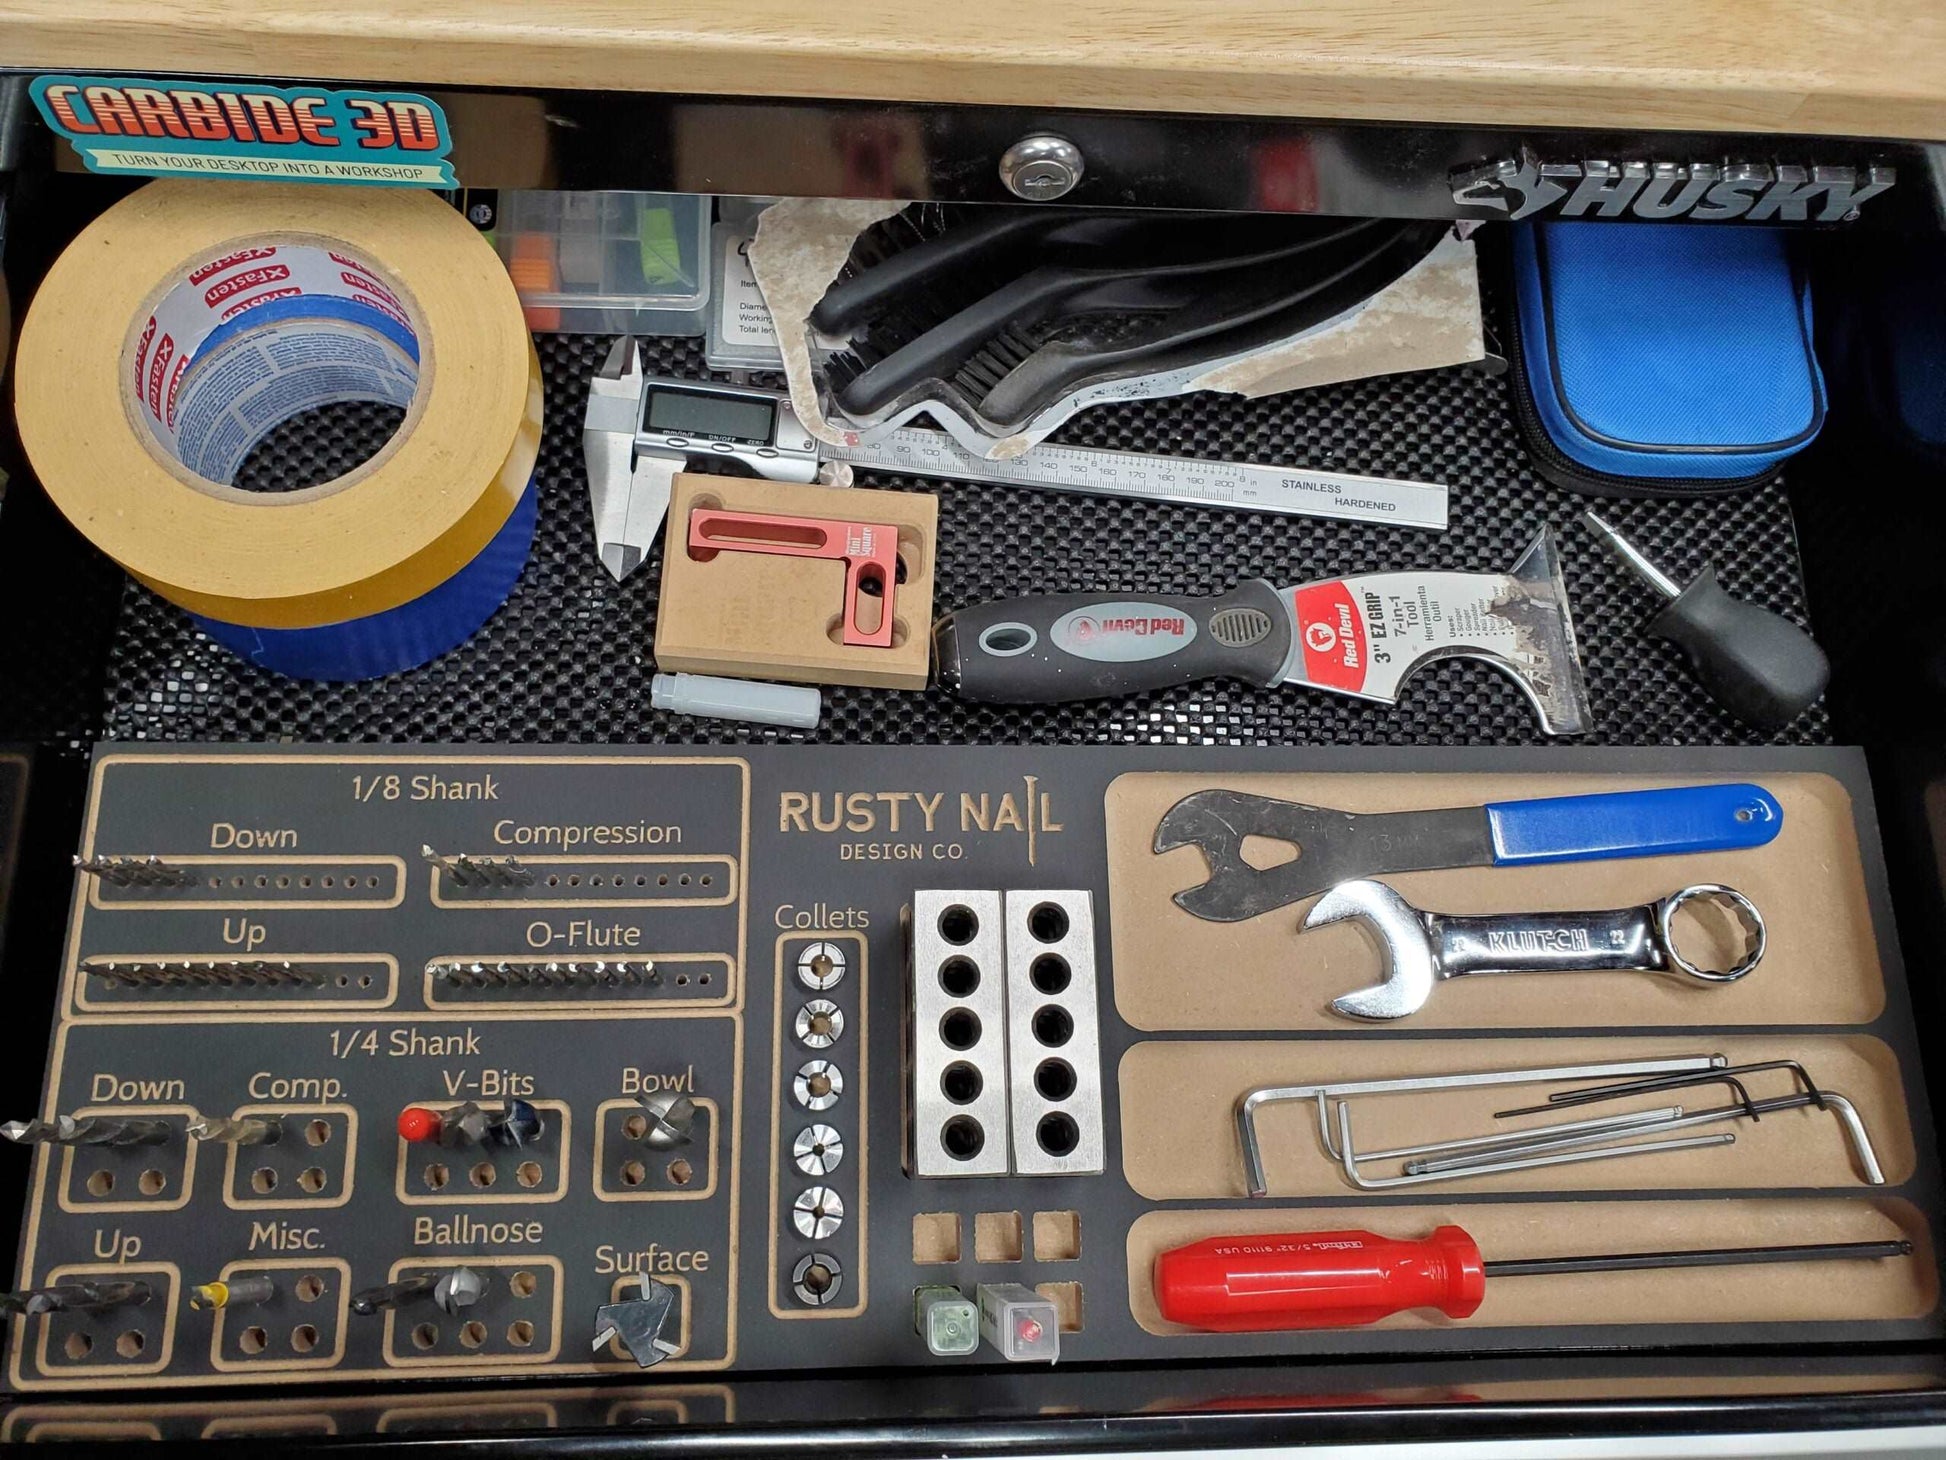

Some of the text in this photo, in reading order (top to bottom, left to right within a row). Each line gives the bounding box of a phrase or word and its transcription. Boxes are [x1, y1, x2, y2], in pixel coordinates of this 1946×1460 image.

[44, 84, 441, 151] CARBIDE 3D
[112, 153, 424, 180] TURN YOUR DESKTOP INTO A WORKSHOP
[1556, 163, 1896, 221] HUSKY
[207, 267, 286, 302] XFasten
[739, 325, 759, 334] Total
[150, 339, 173, 417] XFasten
[897, 445, 911, 453] 90
[922, 448, 940, 457] 100
[953, 452, 970, 460] 110
[1010, 458, 1029, 467] 130
[1040, 461, 1058, 470] 140
[1070, 465, 1088, 473] 150
[1128, 471, 1147, 479] 170
[1187, 477, 1205, 485] 190
[1214, 480, 1235, 488] 200
[1281, 479, 1342, 494] STAINLESS
[1335, 497, 1396, 512] HARDENED
[849, 537, 861, 556] Mini
[861, 526, 873, 557] Square
[1364, 592, 1384, 620] GRIP
[1388, 595, 1407, 638] 7-in-1
[1402, 601, 1420, 628] Tool
[1417, 585, 1435, 641] Herramienta
[1429, 601, 1442, 622] Outil
[1150, 618, 1185, 635] Red
[1334, 603, 1359, 669] Red Devil
[1369, 622, 1387, 639] EZ
[352, 773, 500, 803] 1/8 Shank
[210, 822, 298, 849] Down
[493, 819, 682, 851] Compression
[779, 775, 1065, 867] RUSTY NAIL
[839, 843, 923, 861] DESIGN
[774, 902, 870, 930] Collets
[222, 917, 267, 952] Up
[526, 919, 641, 948] O-Flute
[1487, 928, 1590, 952] KLUTCH
[329, 1027, 482, 1059] 1/4 Shank
[90, 1073, 186, 1102] Down
[248, 1072, 348, 1106] Comp.
[442, 1069, 536, 1097] V-Bits
[621, 1064, 694, 1095] Bowl
[248, 1221, 326, 1251] Misc.
[413, 1214, 544, 1246] Ballnose
[94, 1229, 142, 1265] Up
[595, 1243, 710, 1274] Surface
[1214, 1246, 1240, 1255] USA
